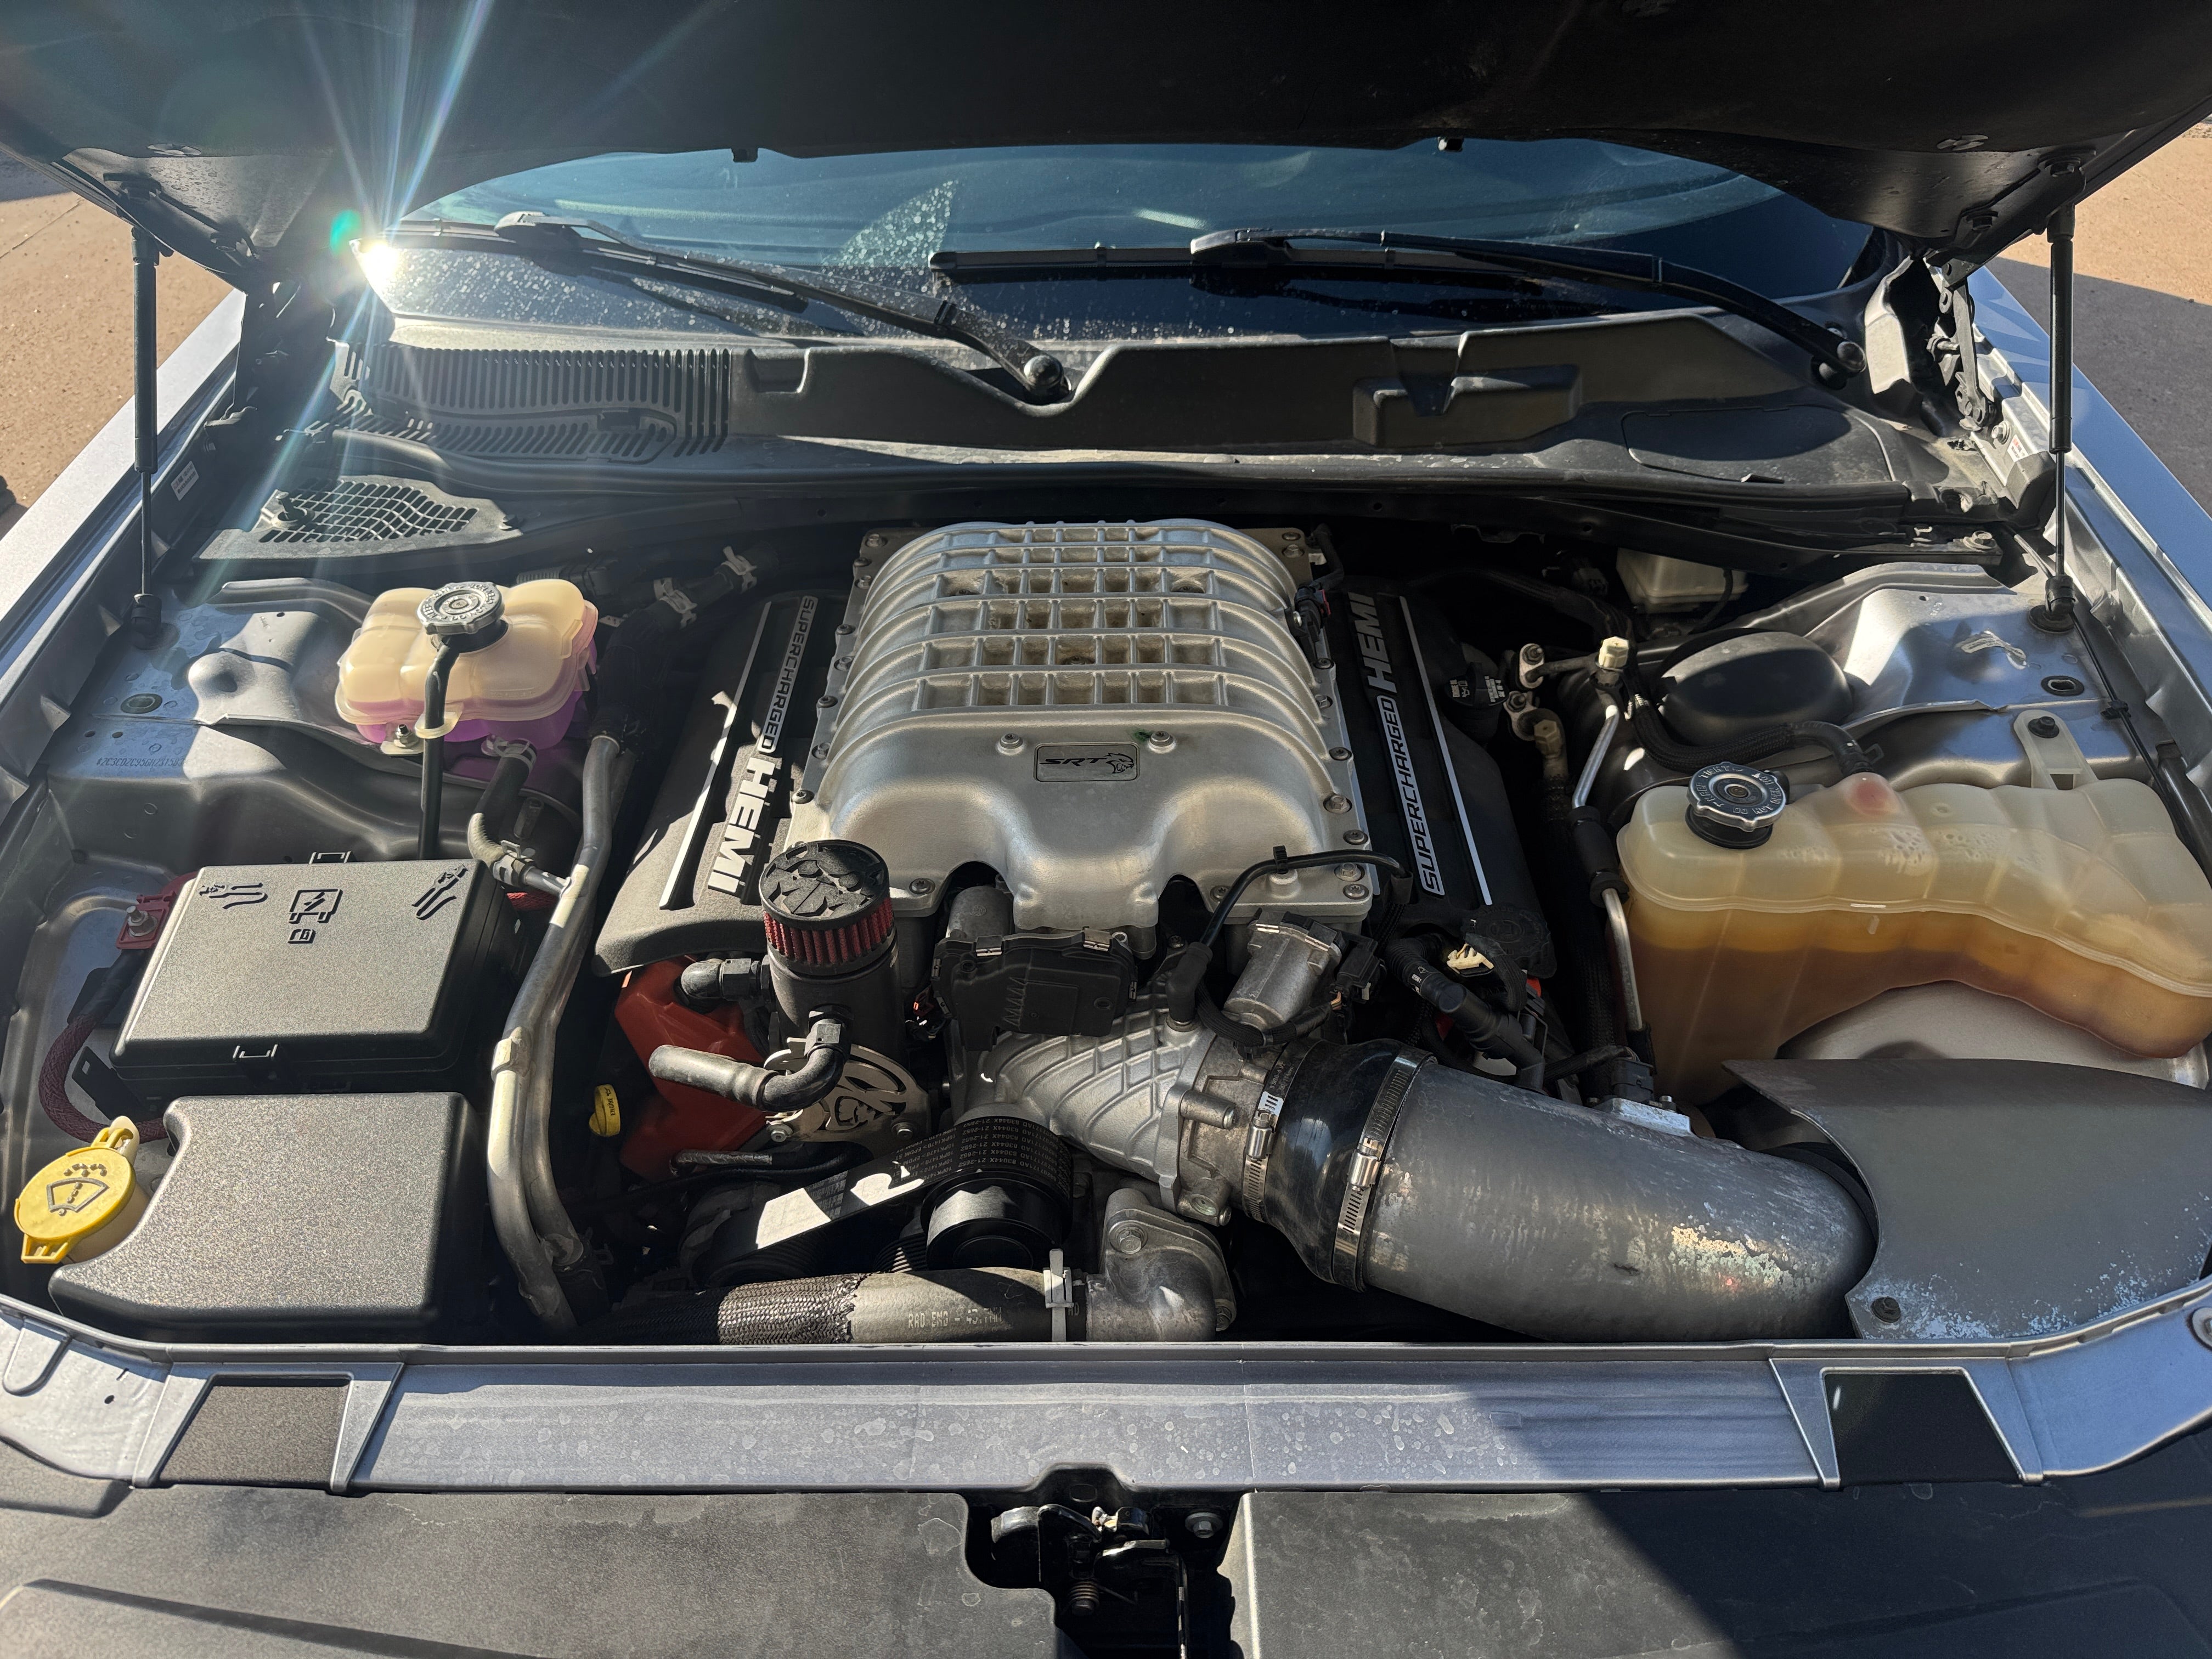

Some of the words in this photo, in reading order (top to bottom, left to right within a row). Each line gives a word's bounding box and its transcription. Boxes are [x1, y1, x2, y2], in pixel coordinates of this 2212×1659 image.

[759, 597, 816, 751] SUPERCHARGED
[1348, 591, 1397, 693] HEMI
[1039, 758, 1108, 766] SRT
[1379, 696, 1442, 894] SUPERCHARGED
[708, 757, 776, 894] HEMI
[607, 1097, 616, 1116] ENGINE
[908, 1313, 925, 1328] RAD
